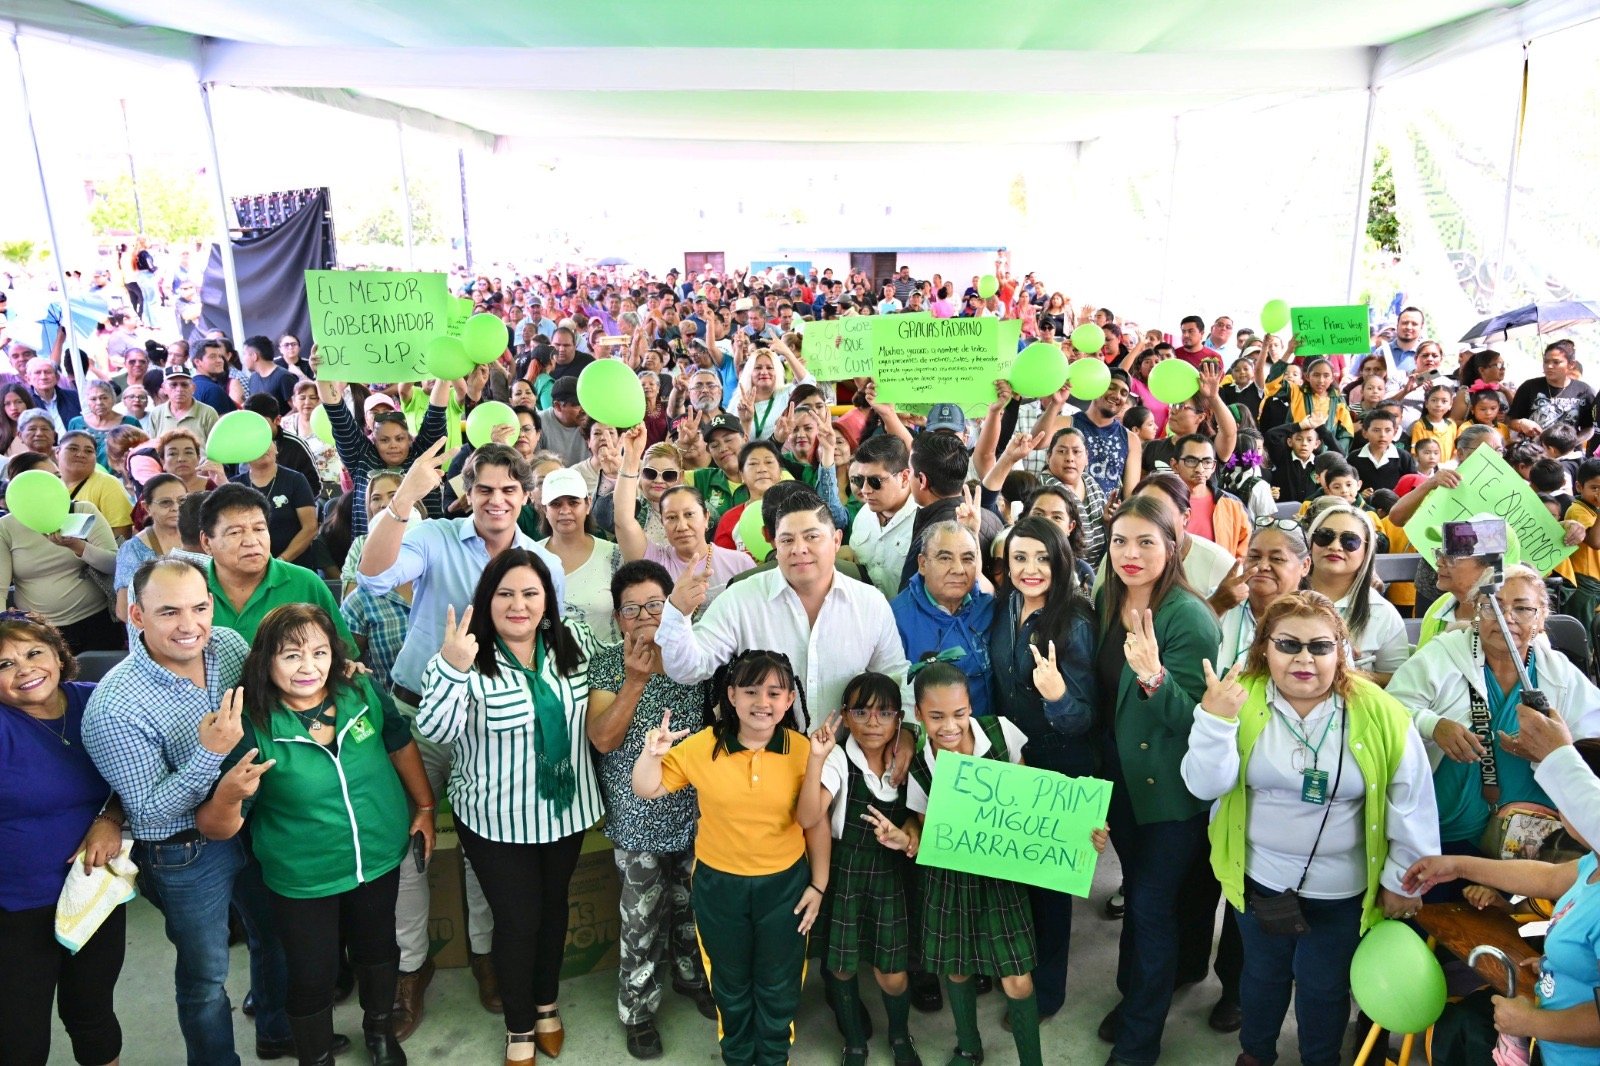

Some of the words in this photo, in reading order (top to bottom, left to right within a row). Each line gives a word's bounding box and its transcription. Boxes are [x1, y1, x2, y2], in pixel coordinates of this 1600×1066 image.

[318, 276, 339, 304] EL
[350, 278, 422, 304] MEJOR
[323, 311, 433, 336] GOBERNADOR
[898, 320, 940, 339] GRACIAS
[323, 345, 351, 366] DE
[843, 337, 865, 353] QUE
[1470, 453, 1504, 502] TE
[1493, 490, 1562, 571] QUEREMOS
[1032, 776, 1103, 820] PRIM
[975, 806, 1066, 843] MIGUEL
